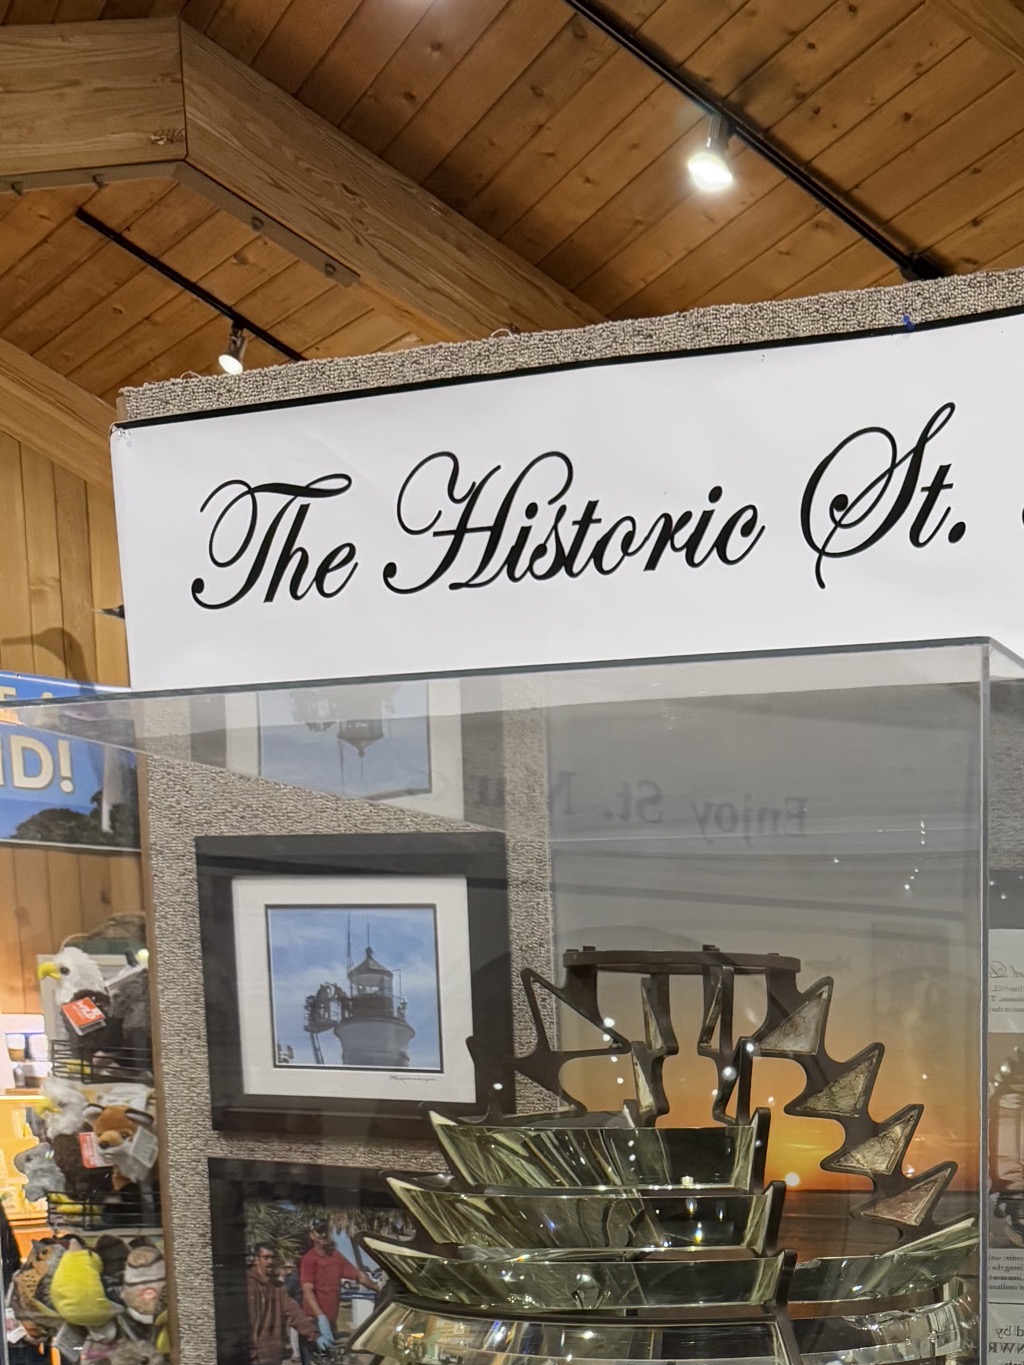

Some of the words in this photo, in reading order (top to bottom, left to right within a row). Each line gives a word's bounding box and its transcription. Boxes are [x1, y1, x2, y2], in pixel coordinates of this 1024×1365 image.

[191, 473, 356, 609] The
[383, 451, 766, 591] Historic
[801, 401, 967, 589] St.
[0, 735, 74, 793] D!
